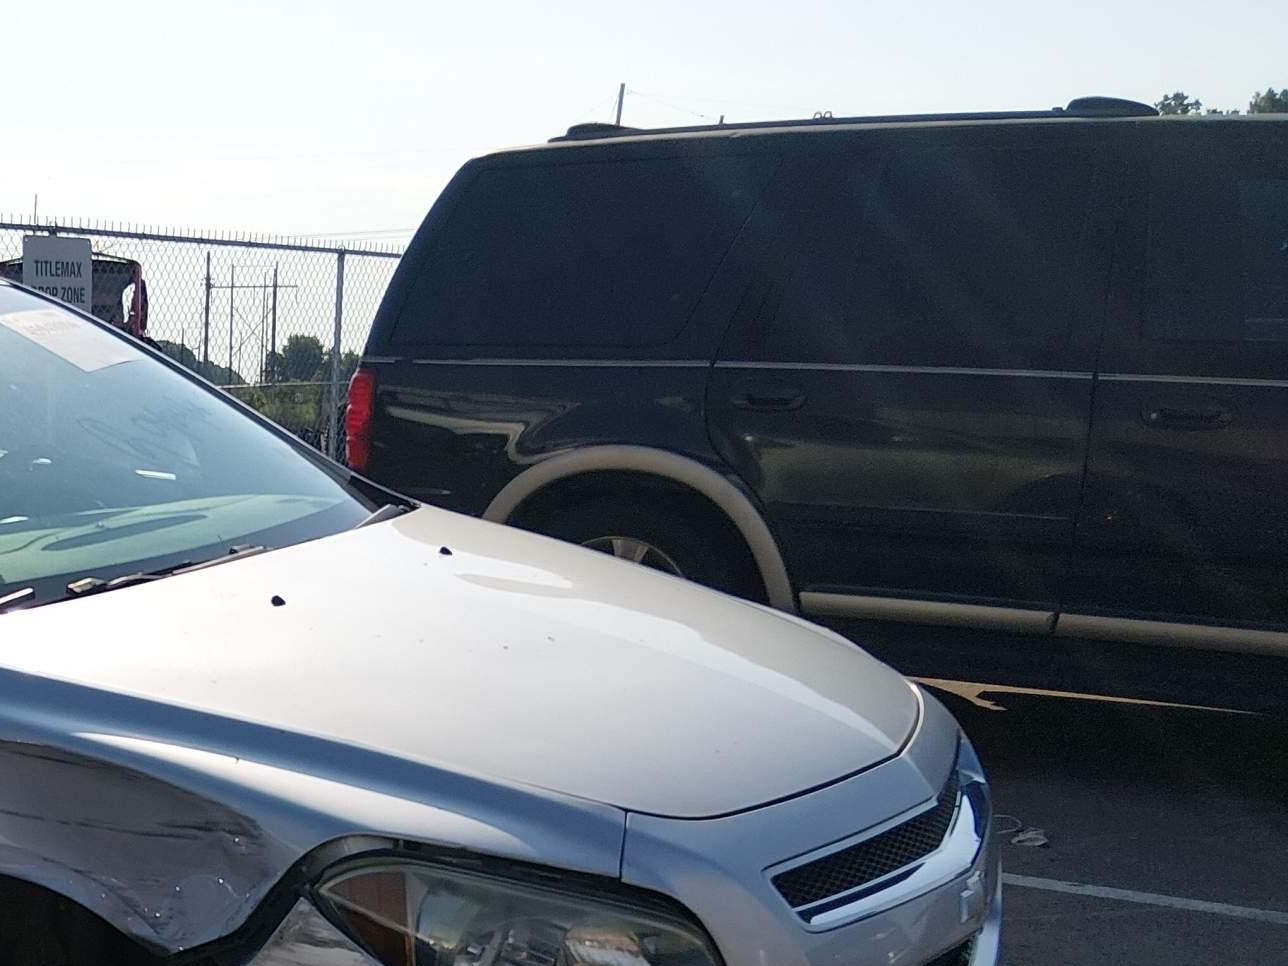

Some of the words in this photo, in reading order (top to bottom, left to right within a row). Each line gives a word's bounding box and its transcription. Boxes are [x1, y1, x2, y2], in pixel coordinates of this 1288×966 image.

[34, 260, 82, 278] TITLEMAX
[31, 286, 58, 297] OP
[61, 287, 86, 304] ZONE
